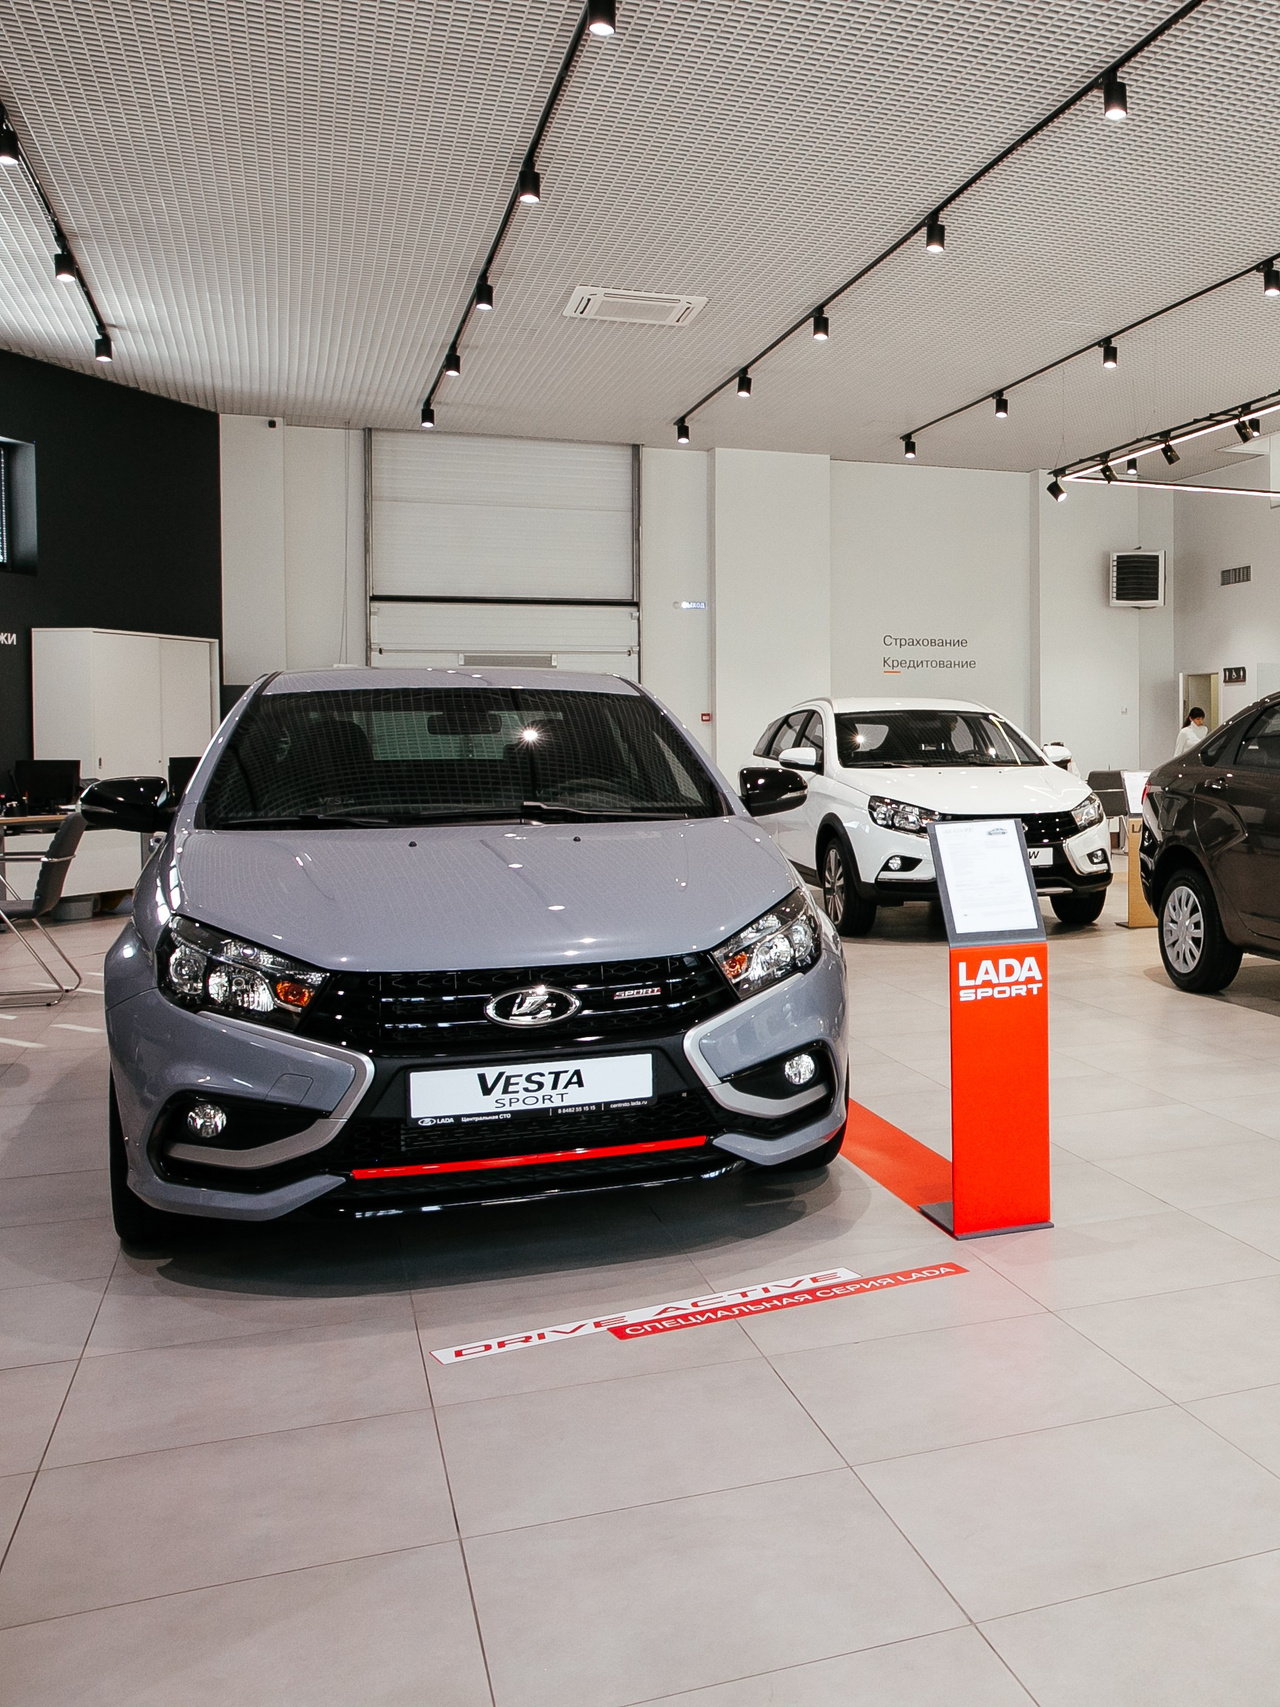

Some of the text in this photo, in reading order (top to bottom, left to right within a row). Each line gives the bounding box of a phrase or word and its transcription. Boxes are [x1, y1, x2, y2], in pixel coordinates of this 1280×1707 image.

[883, 634, 968, 649] Страхование
[882, 656, 977, 670] Кредитование
[958, 956, 1043, 987] LADA
[615, 987, 660, 998] SPORT
[959, 983, 1043, 1002] SPORT
[476, 1068, 586, 1097] VESTA
[494, 1092, 569, 1109] SPORT
[461, 1114, 499, 1122] Центральная
[625, 1266, 956, 1335] СПЕЦИАЛЬНАЯ СЕРИЯ LADA
[454, 1271, 843, 1358] DRIVE ACTIVE
